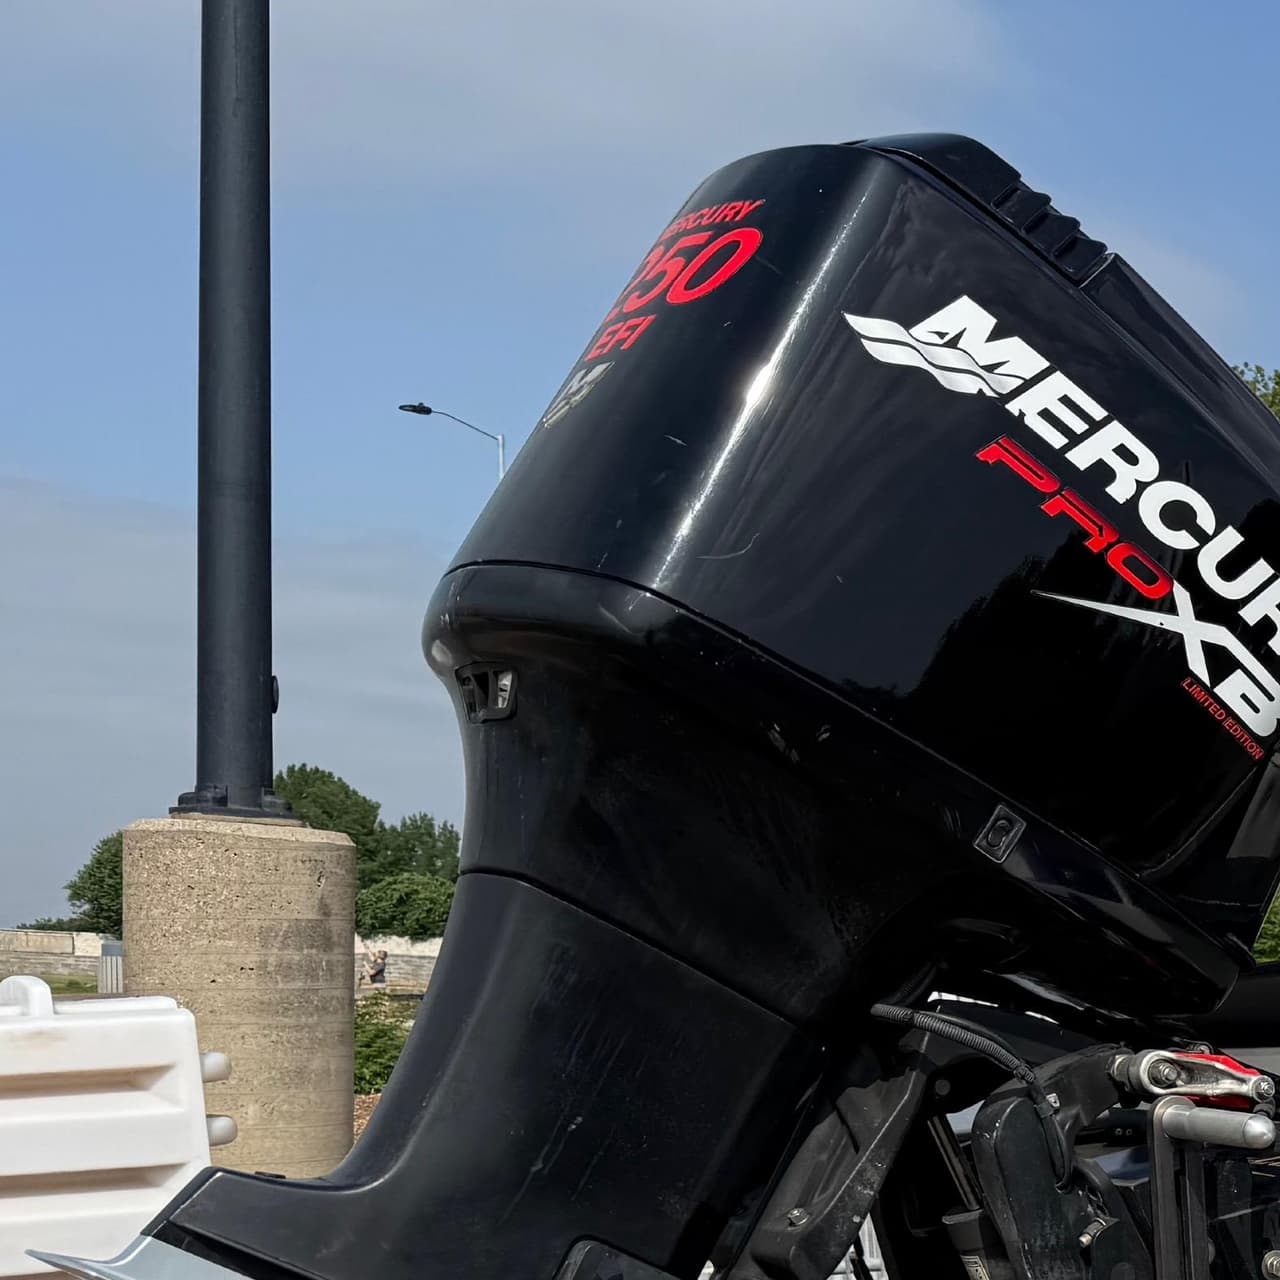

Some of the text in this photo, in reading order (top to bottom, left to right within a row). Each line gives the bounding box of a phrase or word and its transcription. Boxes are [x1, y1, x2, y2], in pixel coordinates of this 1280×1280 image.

[584, 314, 656, 361] EFI
[1180, 676, 1265, 761] LIMITED EDITION
